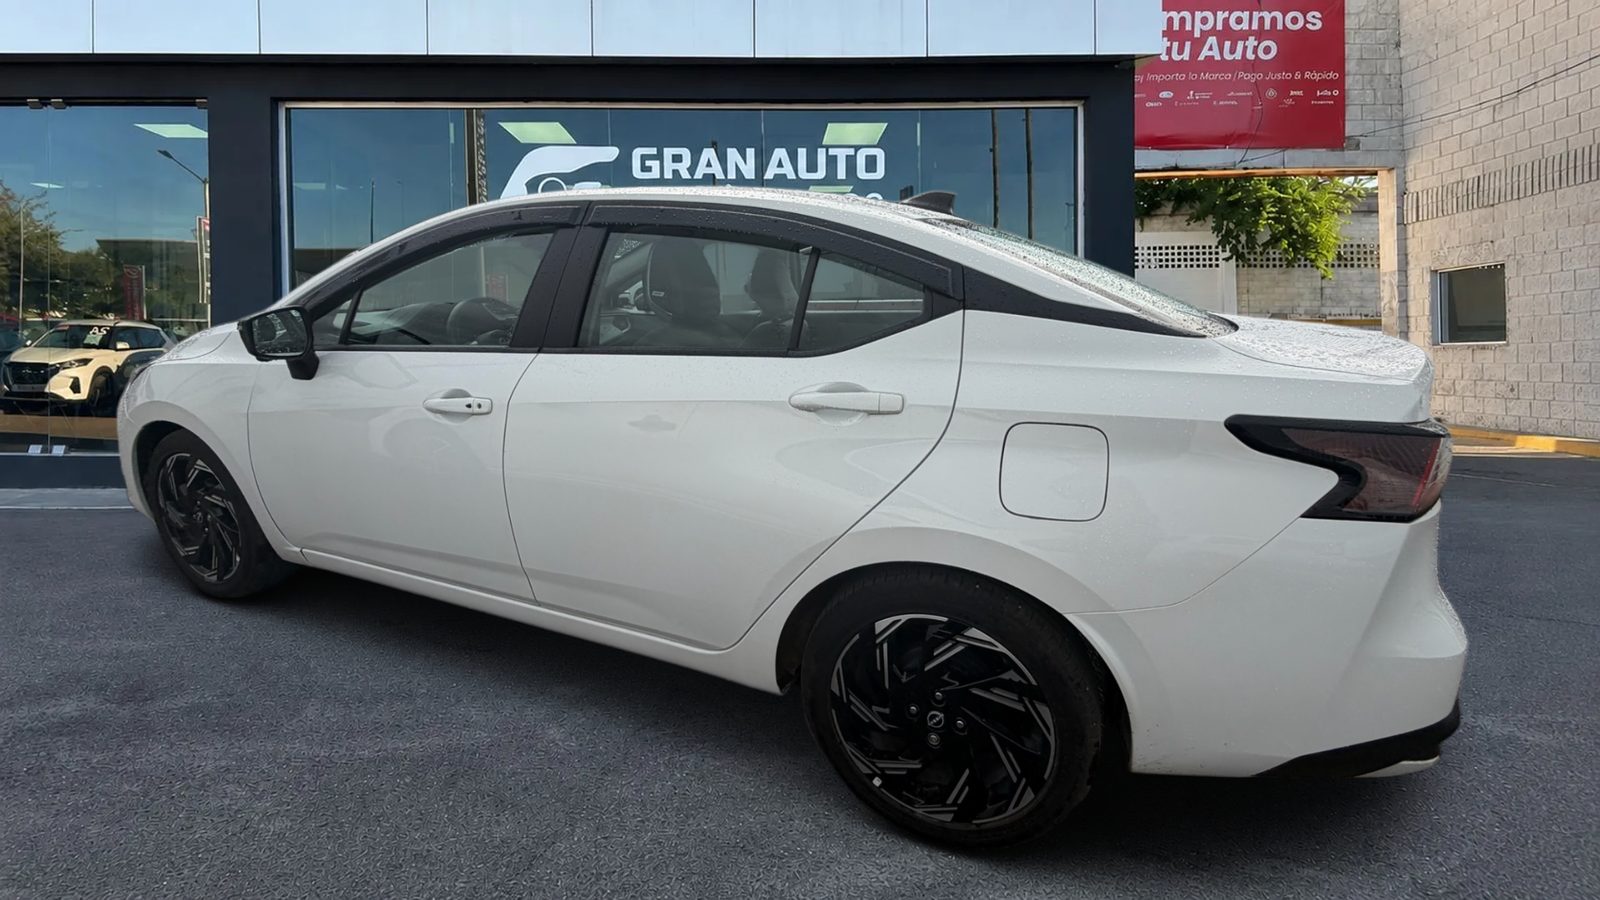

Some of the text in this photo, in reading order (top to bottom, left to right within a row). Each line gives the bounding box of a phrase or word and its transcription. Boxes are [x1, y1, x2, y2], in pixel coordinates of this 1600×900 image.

[1160, 36, 1278, 61] tu Auto
[1146, 72, 1186, 83] Importa
[1199, 72, 1232, 80] Marca
[1265, 71, 1292, 80] Justo
[1294, 71, 1301, 80] &
[631, 147, 885, 180] GRAN AUTO
